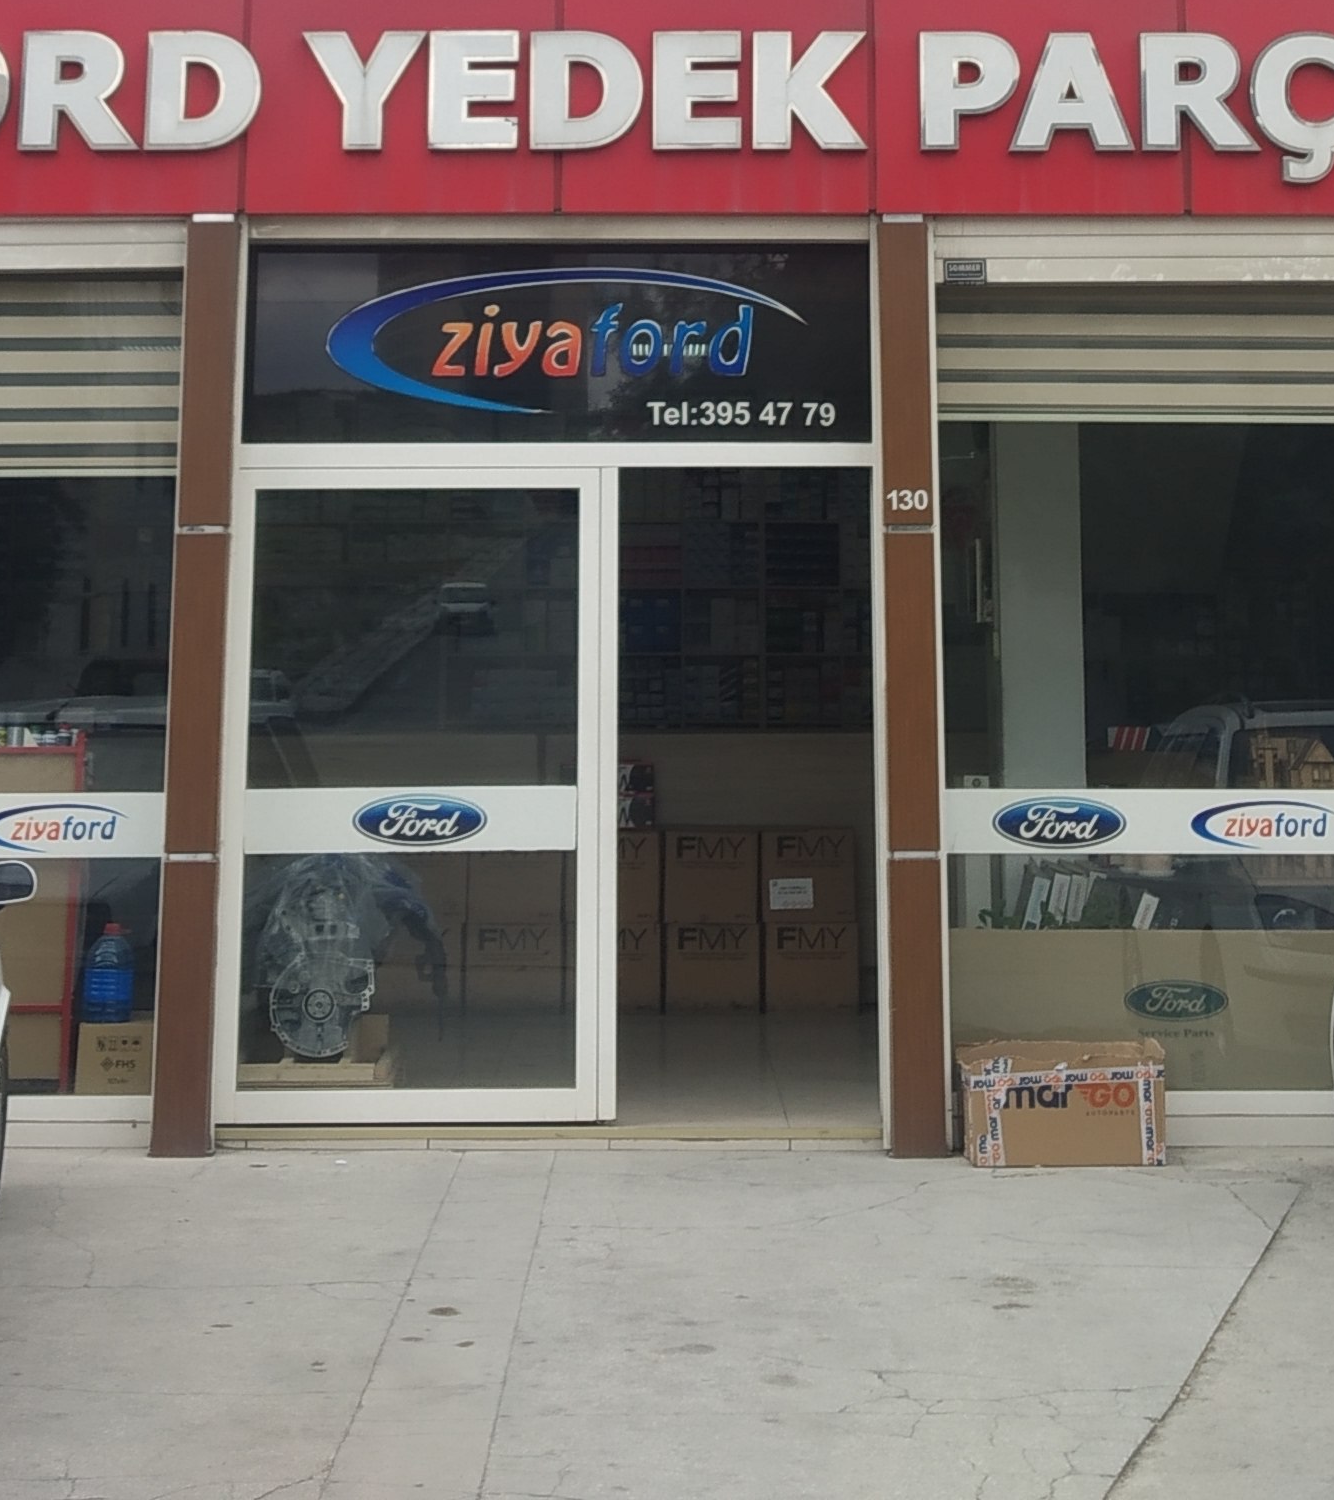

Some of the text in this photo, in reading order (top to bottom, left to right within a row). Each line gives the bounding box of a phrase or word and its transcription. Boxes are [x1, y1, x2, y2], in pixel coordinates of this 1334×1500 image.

[301, 30, 868, 151] YEDEK
[431, 302, 754, 379] ziyaford
[759, 402, 793, 427] 47
[802, 403, 836, 428] 79
[885, 488, 929, 512] 130
[9, 816, 117, 842] ziyaford
[378, 802, 461, 839] Ford
[1019, 807, 1101, 840] Ford
[1223, 812, 1328, 839] ziyaford
[676, 835, 746, 860] FMY
[777, 834, 846, 859] FMY
[678, 927, 747, 950] FMY
[777, 926, 846, 950] FMY
[1145, 986, 1207, 1013] Ford
[1138, 1029, 1215, 1038] Service Parts
